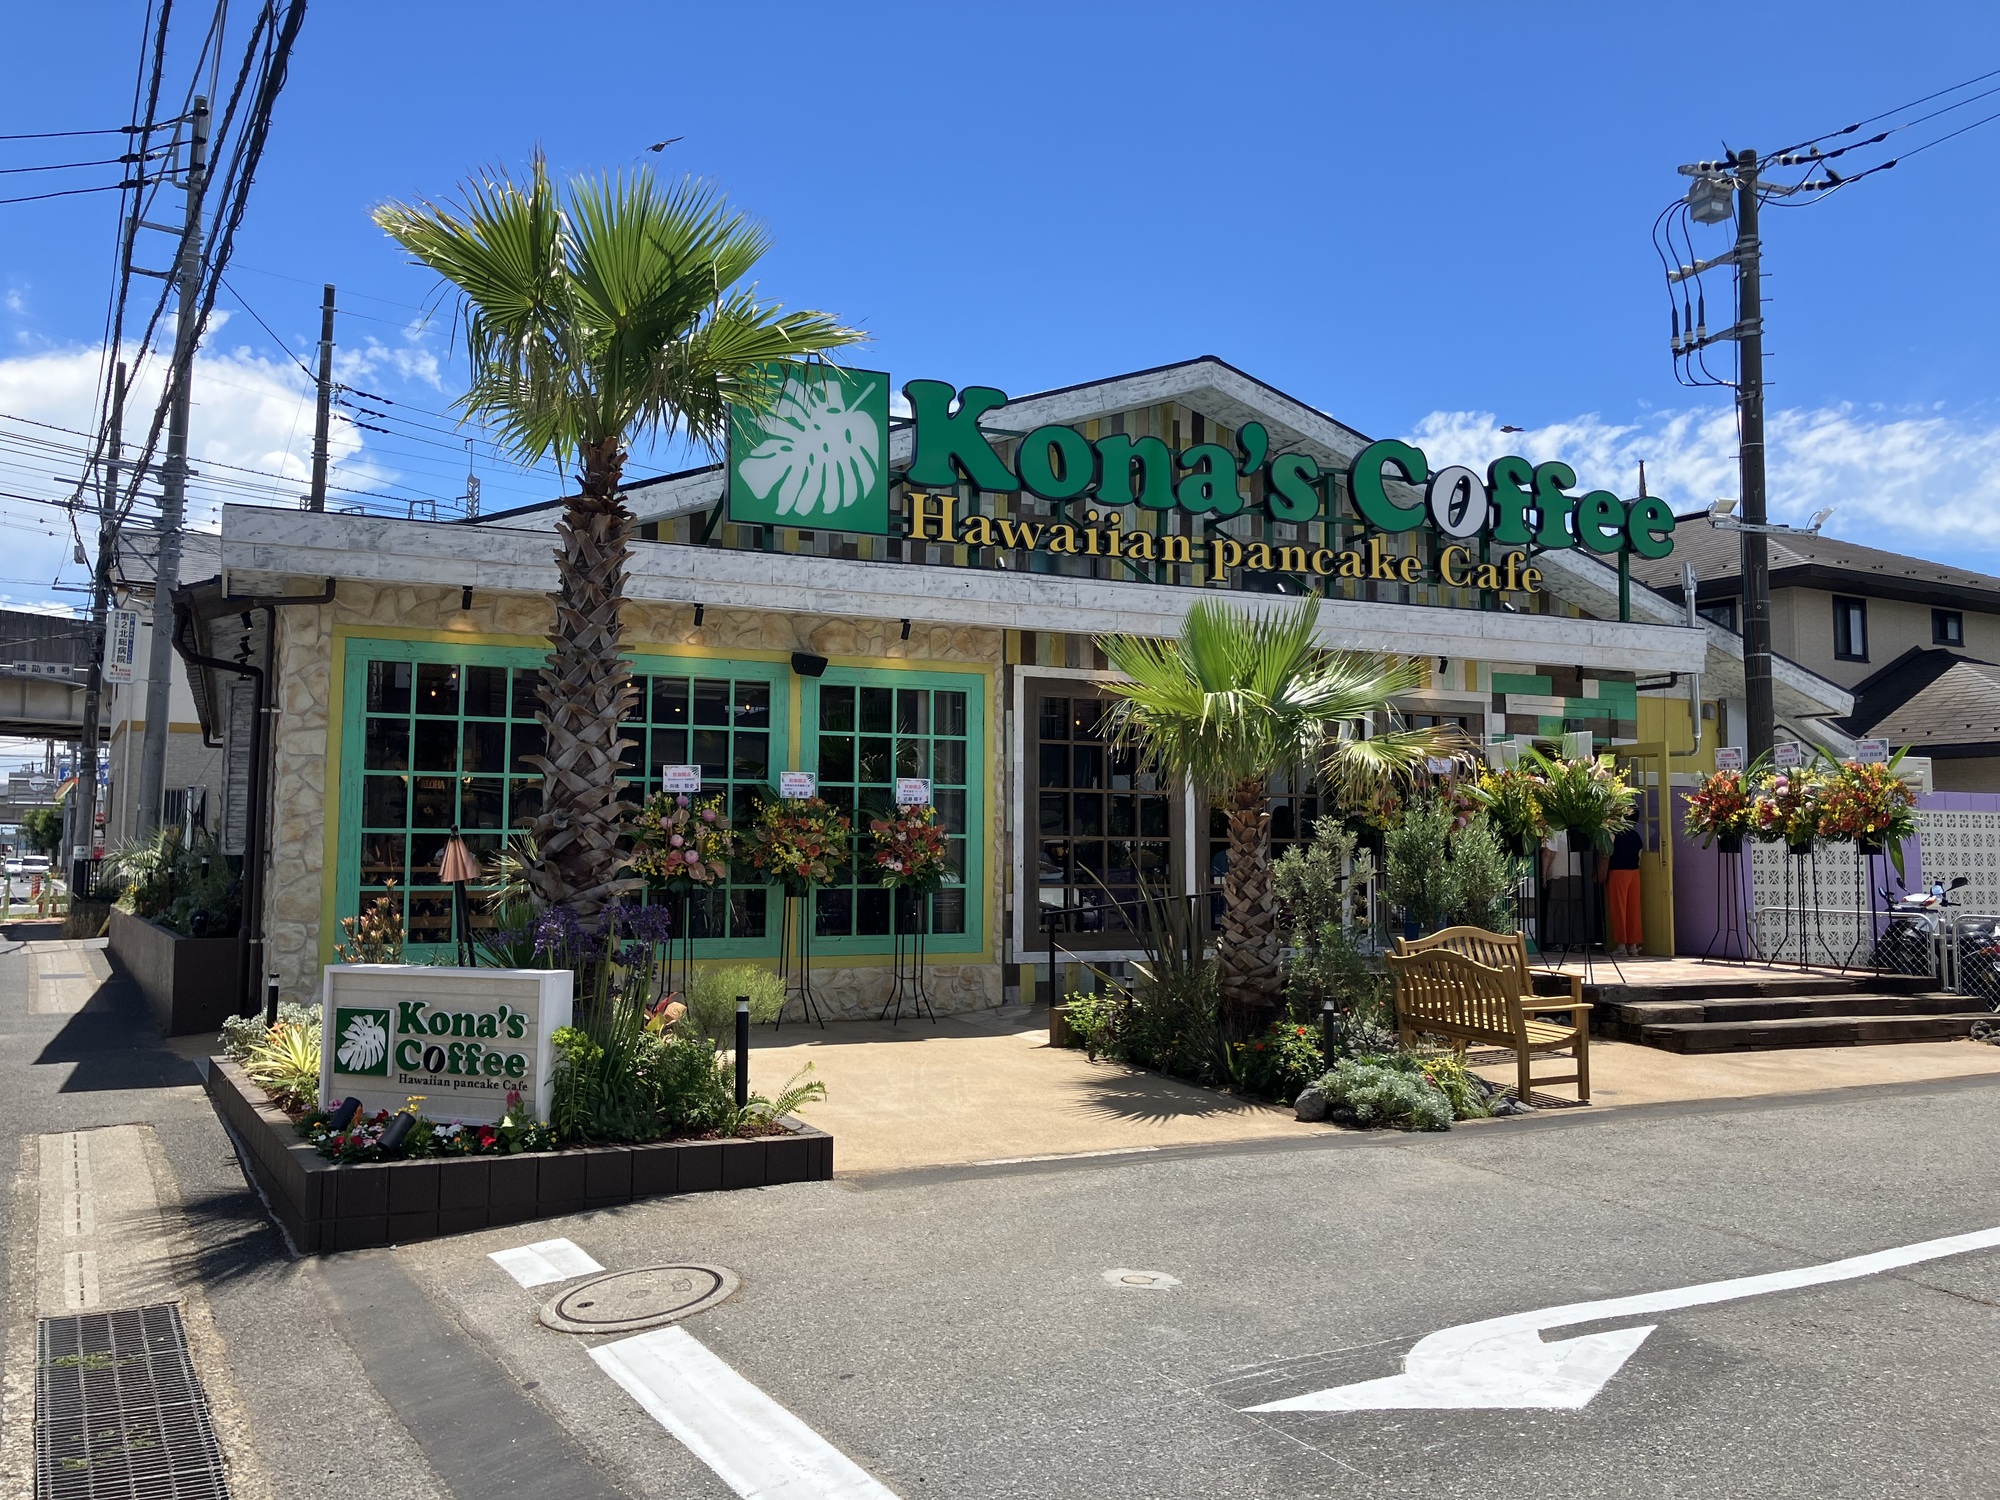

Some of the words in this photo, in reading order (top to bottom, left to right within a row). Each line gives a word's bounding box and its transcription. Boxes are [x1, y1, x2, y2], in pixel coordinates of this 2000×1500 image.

[902, 379, 1319, 522] Kona's
[1347, 439, 1675, 559] Coffee
[907, 492, 1193, 564] Hawaiian
[1210, 538, 1422, 583] pancake
[1436, 545, 1543, 593] Cafe
[116, 612, 130, 664] 第2北総病院
[17, 664, 70, 674] 補助信号
[397, 1001, 529, 1039] Kona's
[396, 1038, 530, 1078] Coffee
[398, 1074, 450, 1086] Hawaiian
[453, 1080, 499, 1090] pancake
[502, 1080, 528, 1091] Cafe
